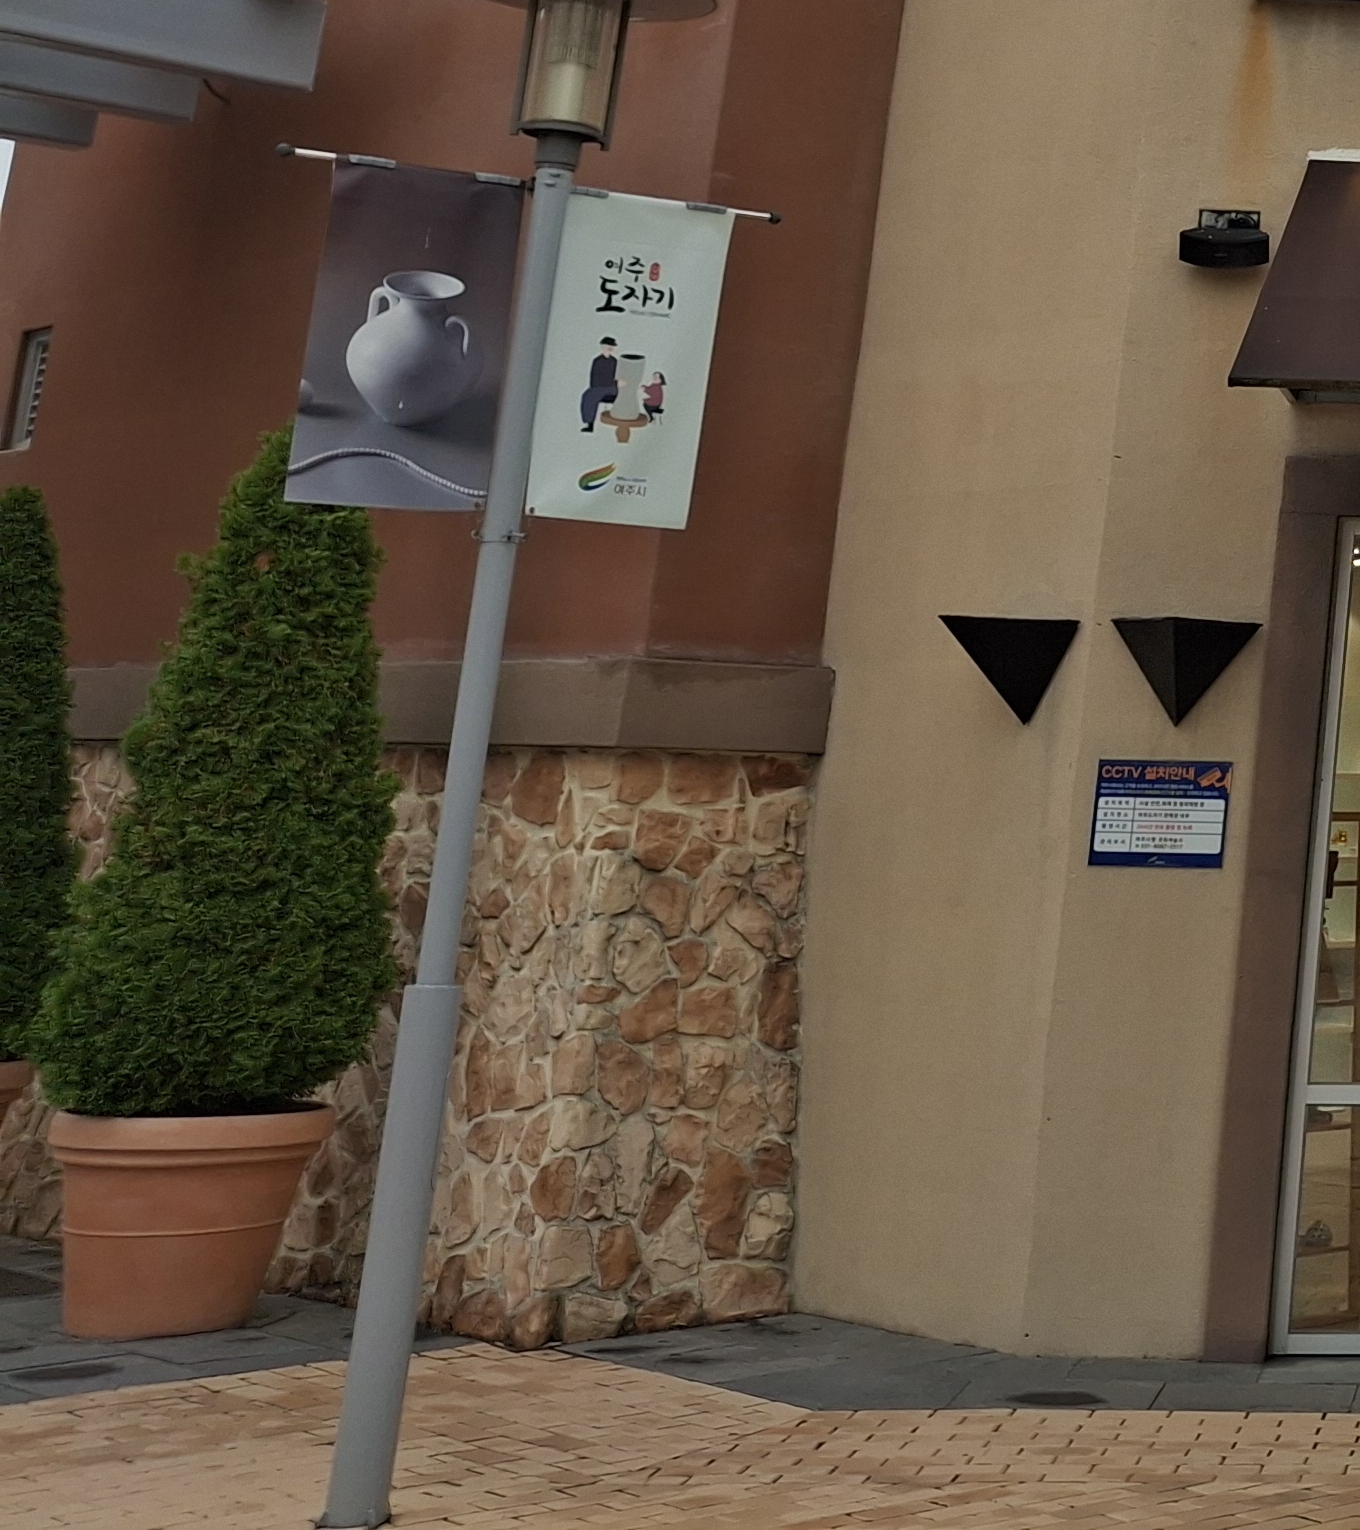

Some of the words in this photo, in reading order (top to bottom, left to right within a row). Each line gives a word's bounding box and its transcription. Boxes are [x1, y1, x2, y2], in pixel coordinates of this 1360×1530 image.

[605, 256, 645, 282] 여주
[595, 275, 675, 313] 도자기
[614, 484, 647, 497] 여주시
[1101, 765, 1142, 779] CCTV
[1144, 765, 1195, 781] 설치안내
